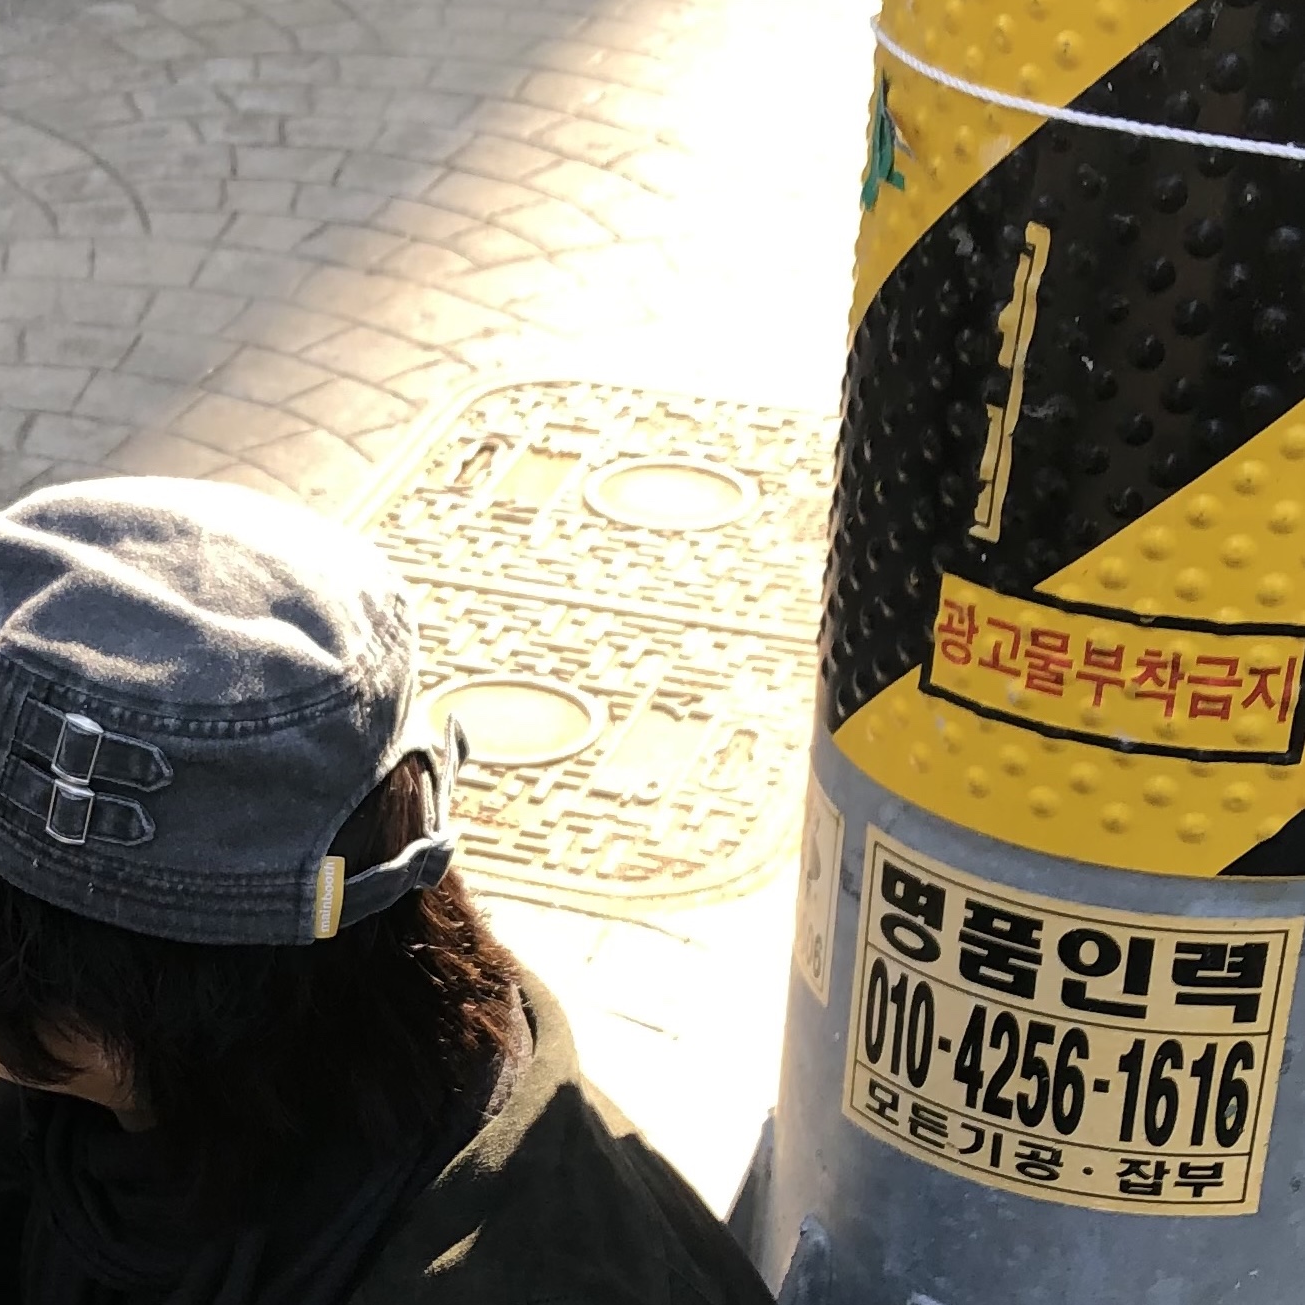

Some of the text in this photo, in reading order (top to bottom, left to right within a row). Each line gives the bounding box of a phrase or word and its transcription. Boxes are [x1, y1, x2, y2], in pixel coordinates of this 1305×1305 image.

[937, 598, 1297, 723] 광고물부착금지
[319, 862, 336, 933] mainbooth
[880, 859, 1271, 1023] 명품인력
[864, 956, 1256, 1149] 010-4256-1616
